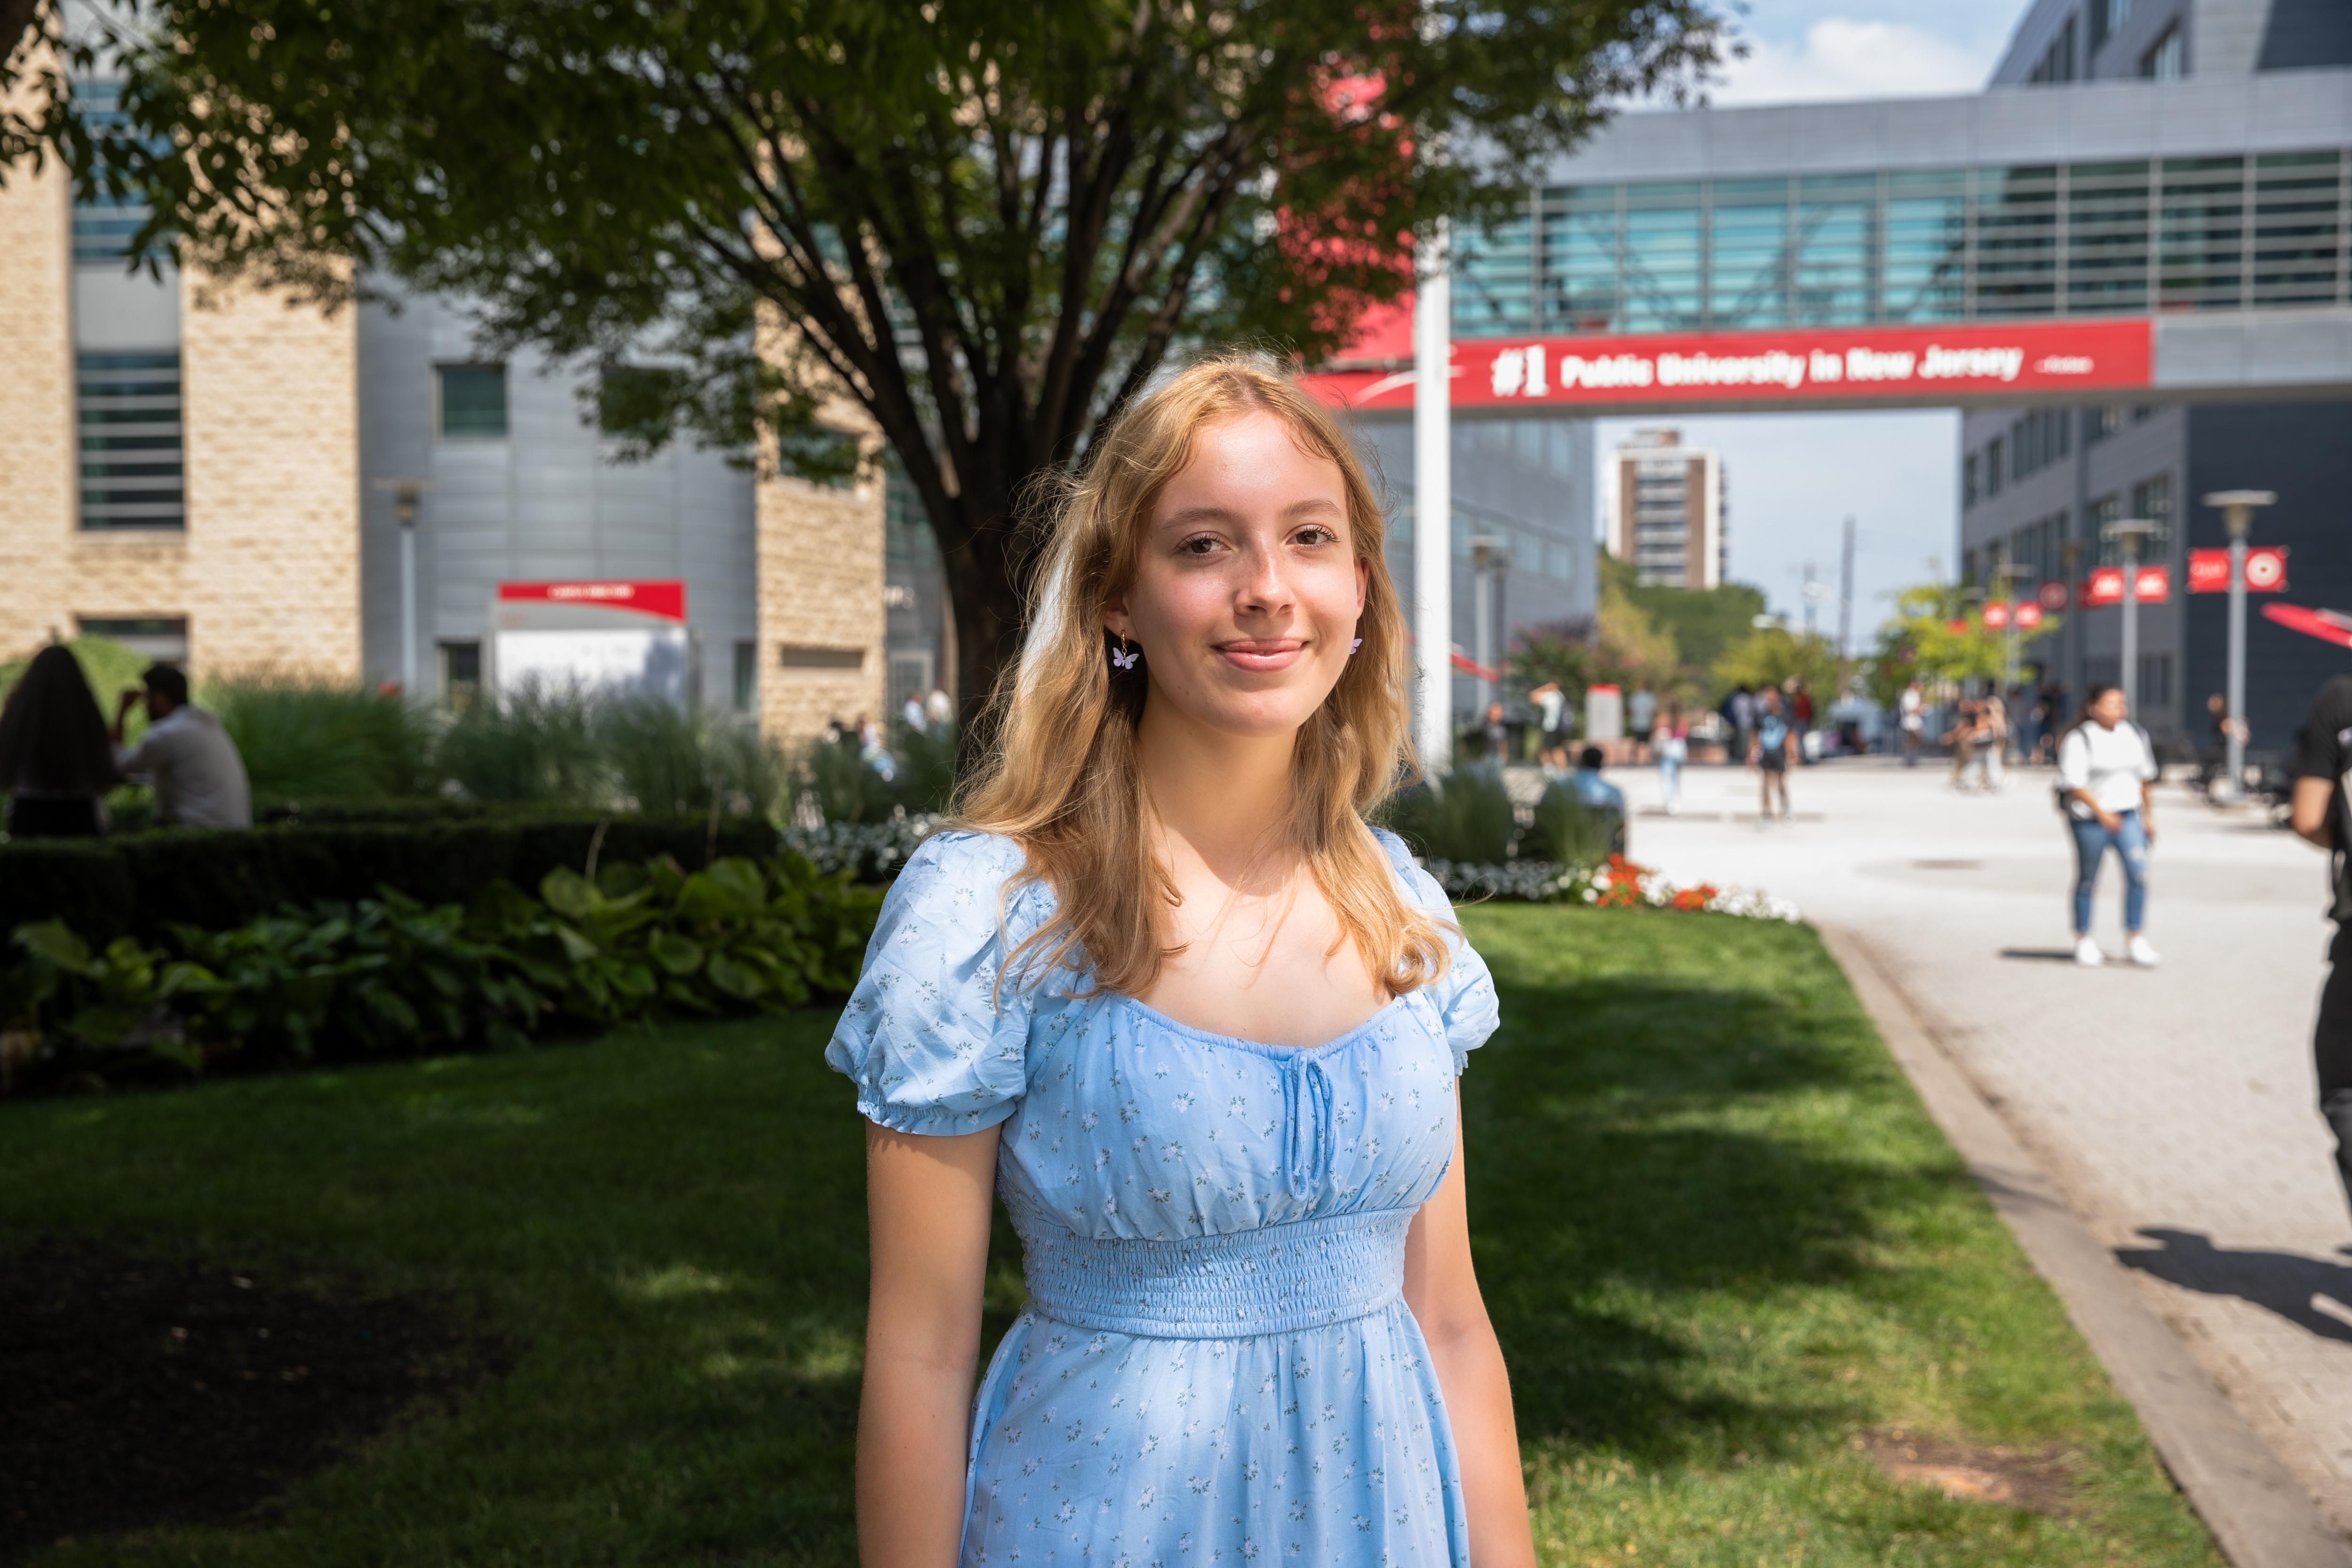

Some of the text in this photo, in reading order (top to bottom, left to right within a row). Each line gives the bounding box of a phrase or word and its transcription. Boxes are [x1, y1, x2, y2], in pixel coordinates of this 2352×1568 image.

[1492, 345, 1549, 396] #1
[1561, 355, 1653, 388] Public
[1657, 351, 1806, 389] University
[1811, 349, 1842, 382] in
[1847, 347, 1915, 381] New
[1917, 344, 2023, 382] Jersey
